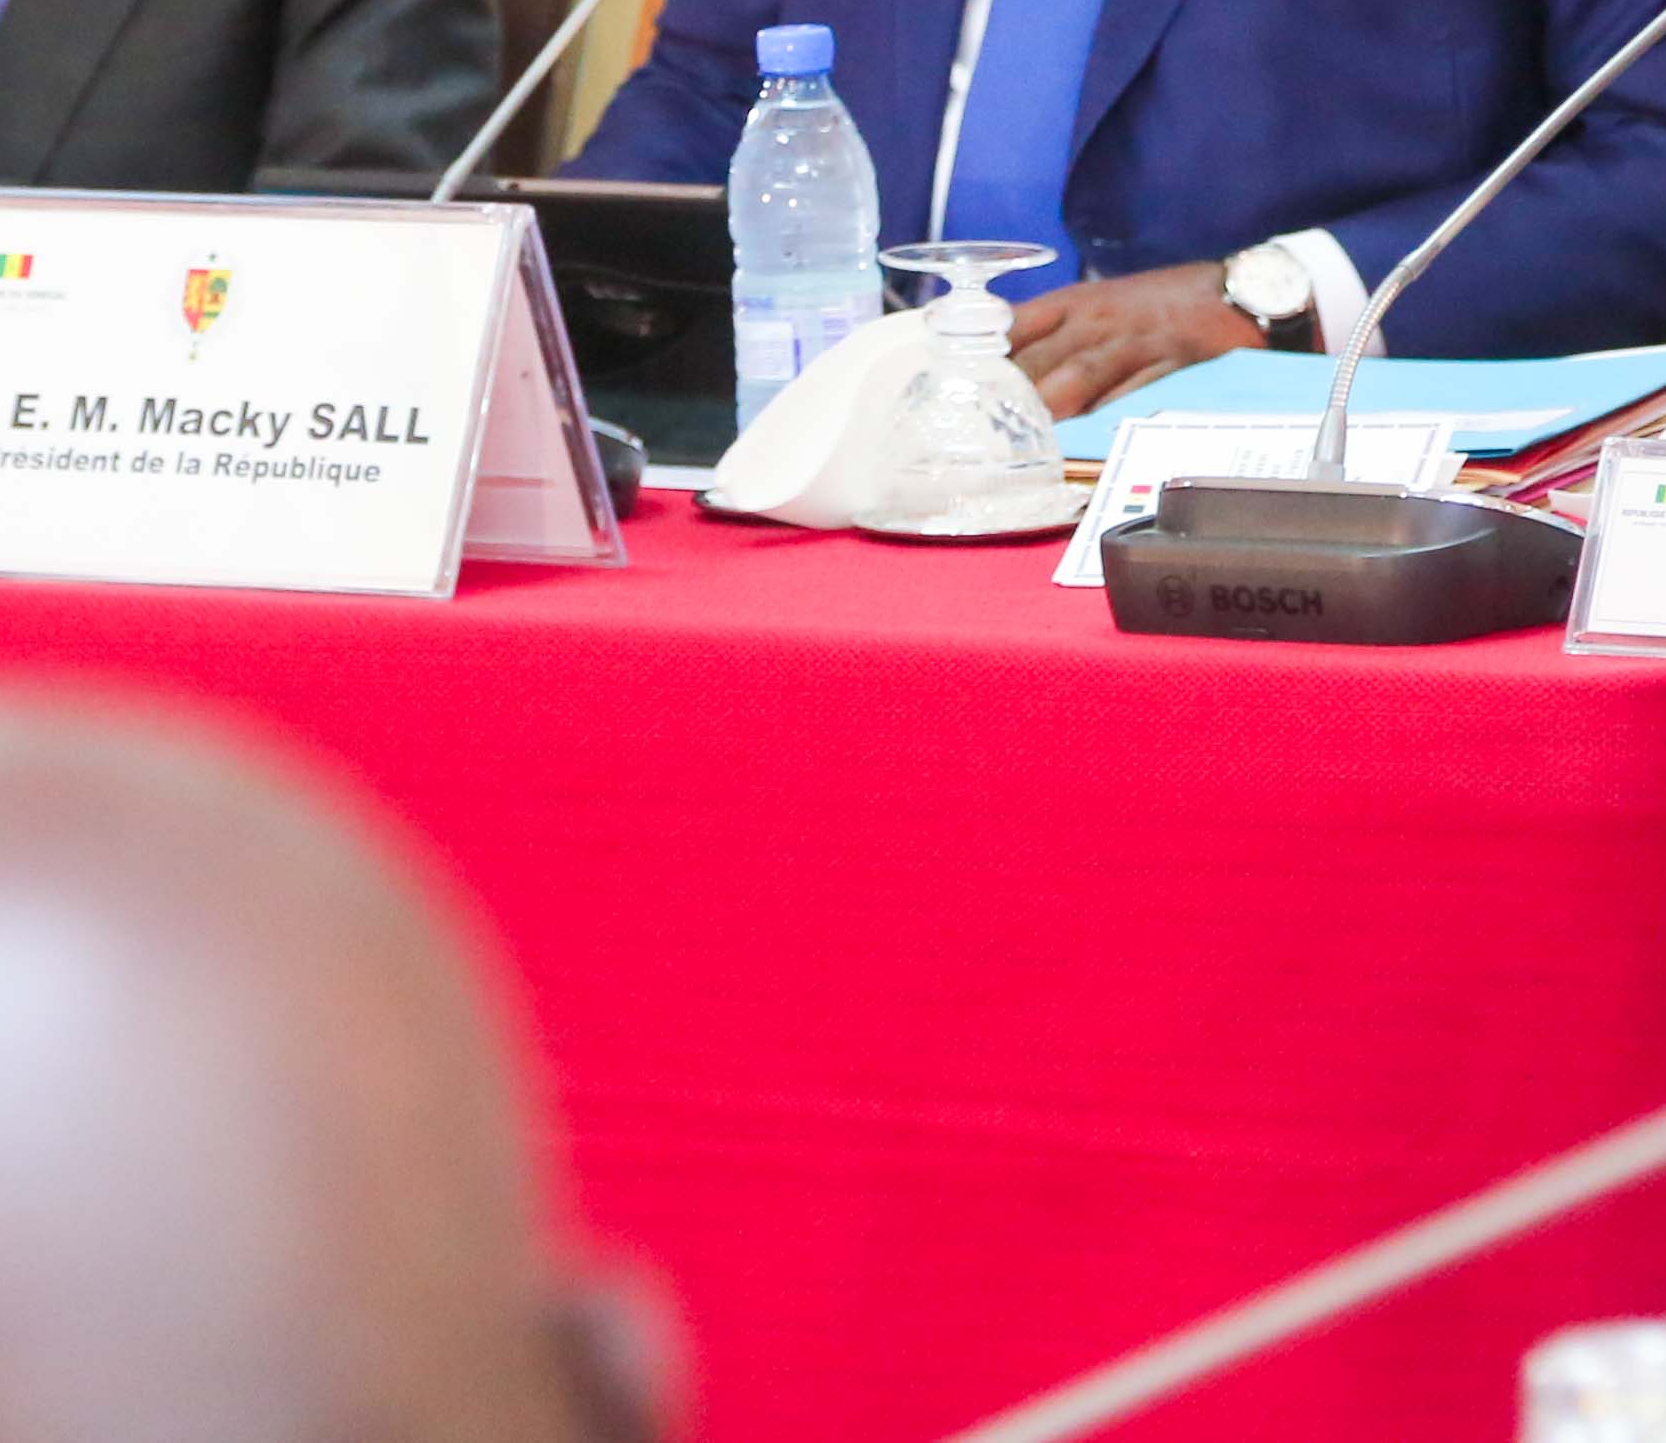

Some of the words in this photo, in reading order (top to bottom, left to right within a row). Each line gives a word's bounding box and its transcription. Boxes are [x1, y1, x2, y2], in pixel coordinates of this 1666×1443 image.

[10, 394, 50, 430] E.
[69, 396, 118, 433] M.
[138, 398, 293, 449] Macky
[307, 403, 431, 445] SALL
[131, 450, 166, 475] de
[175, 452, 202, 476] la
[213, 452, 382, 487] République
[1209, 584, 1324, 616] BOSCH
